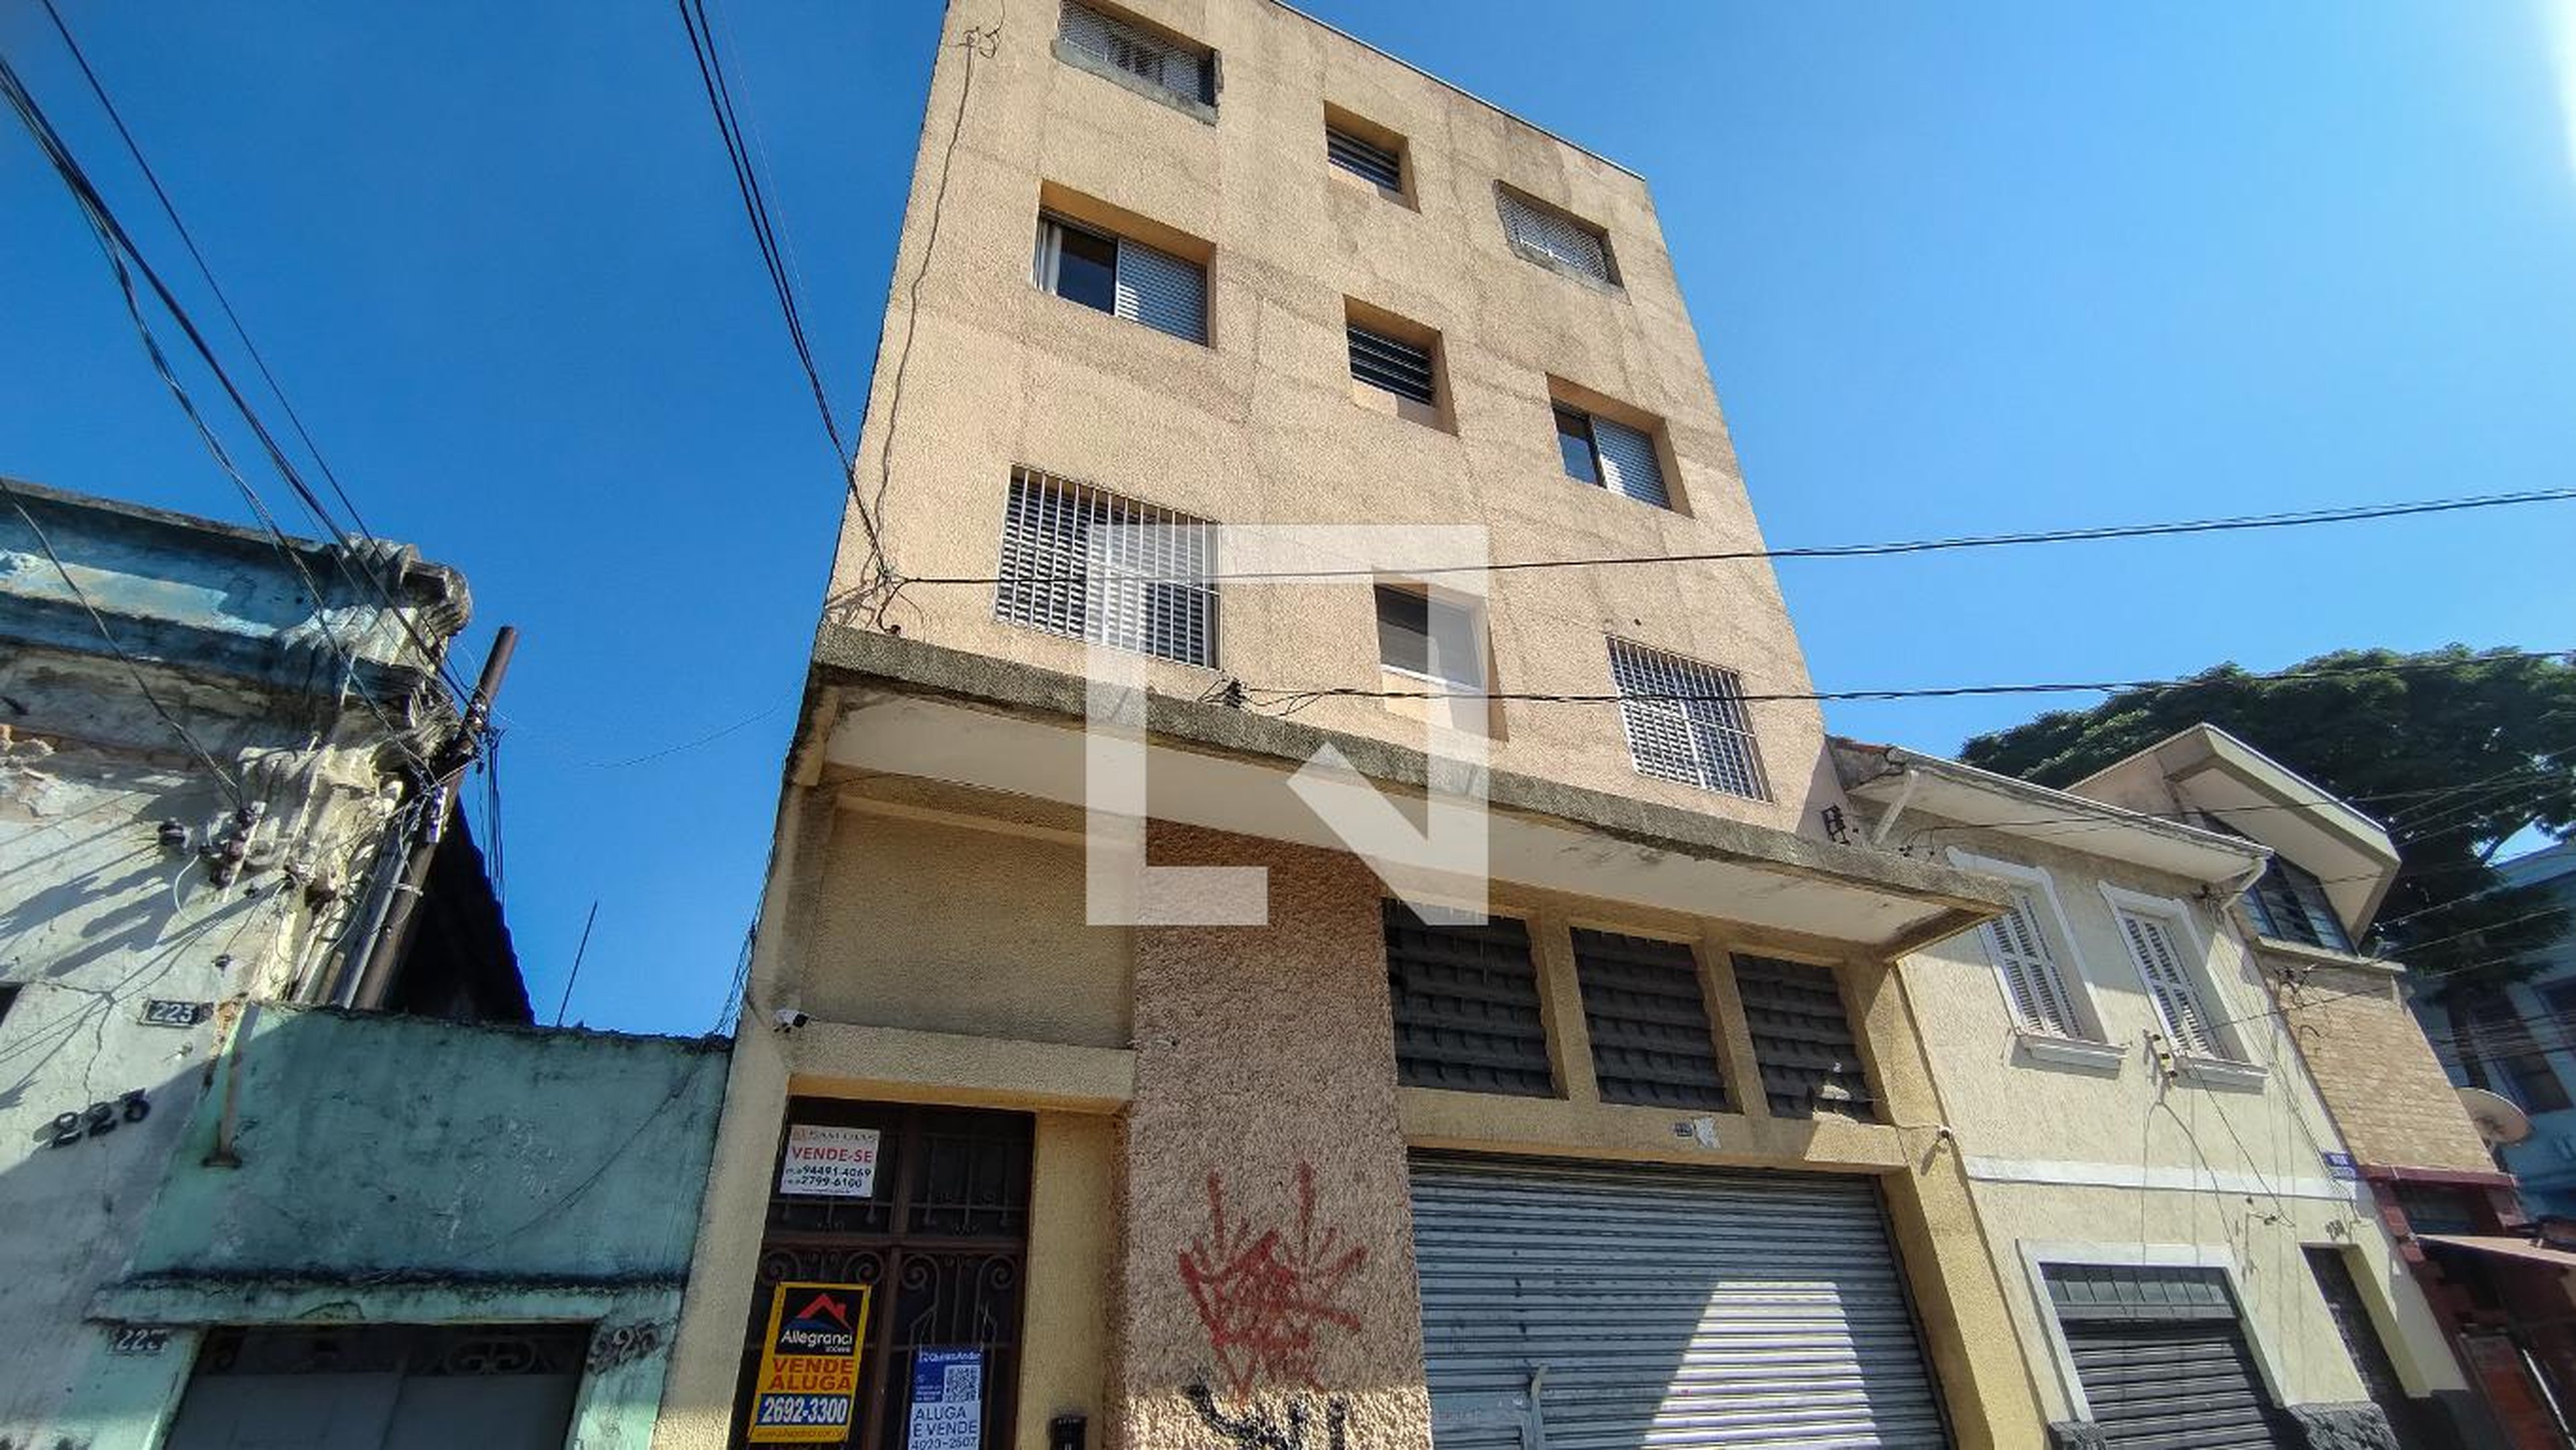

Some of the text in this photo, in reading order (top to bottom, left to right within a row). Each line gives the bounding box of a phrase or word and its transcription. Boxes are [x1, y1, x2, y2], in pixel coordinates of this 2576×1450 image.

[151, 1003, 195, 1022] 223
[792, 1147, 873, 1163] VENDE-SE
[773, 1358, 855, 1374] VENDE
[768, 1375, 852, 1391] ALUGA
[761, 1396, 848, 1423] 2692-3300
[914, 1406, 966, 1422] ALUGA
[914, 1420, 977, 1437] E VENDE
